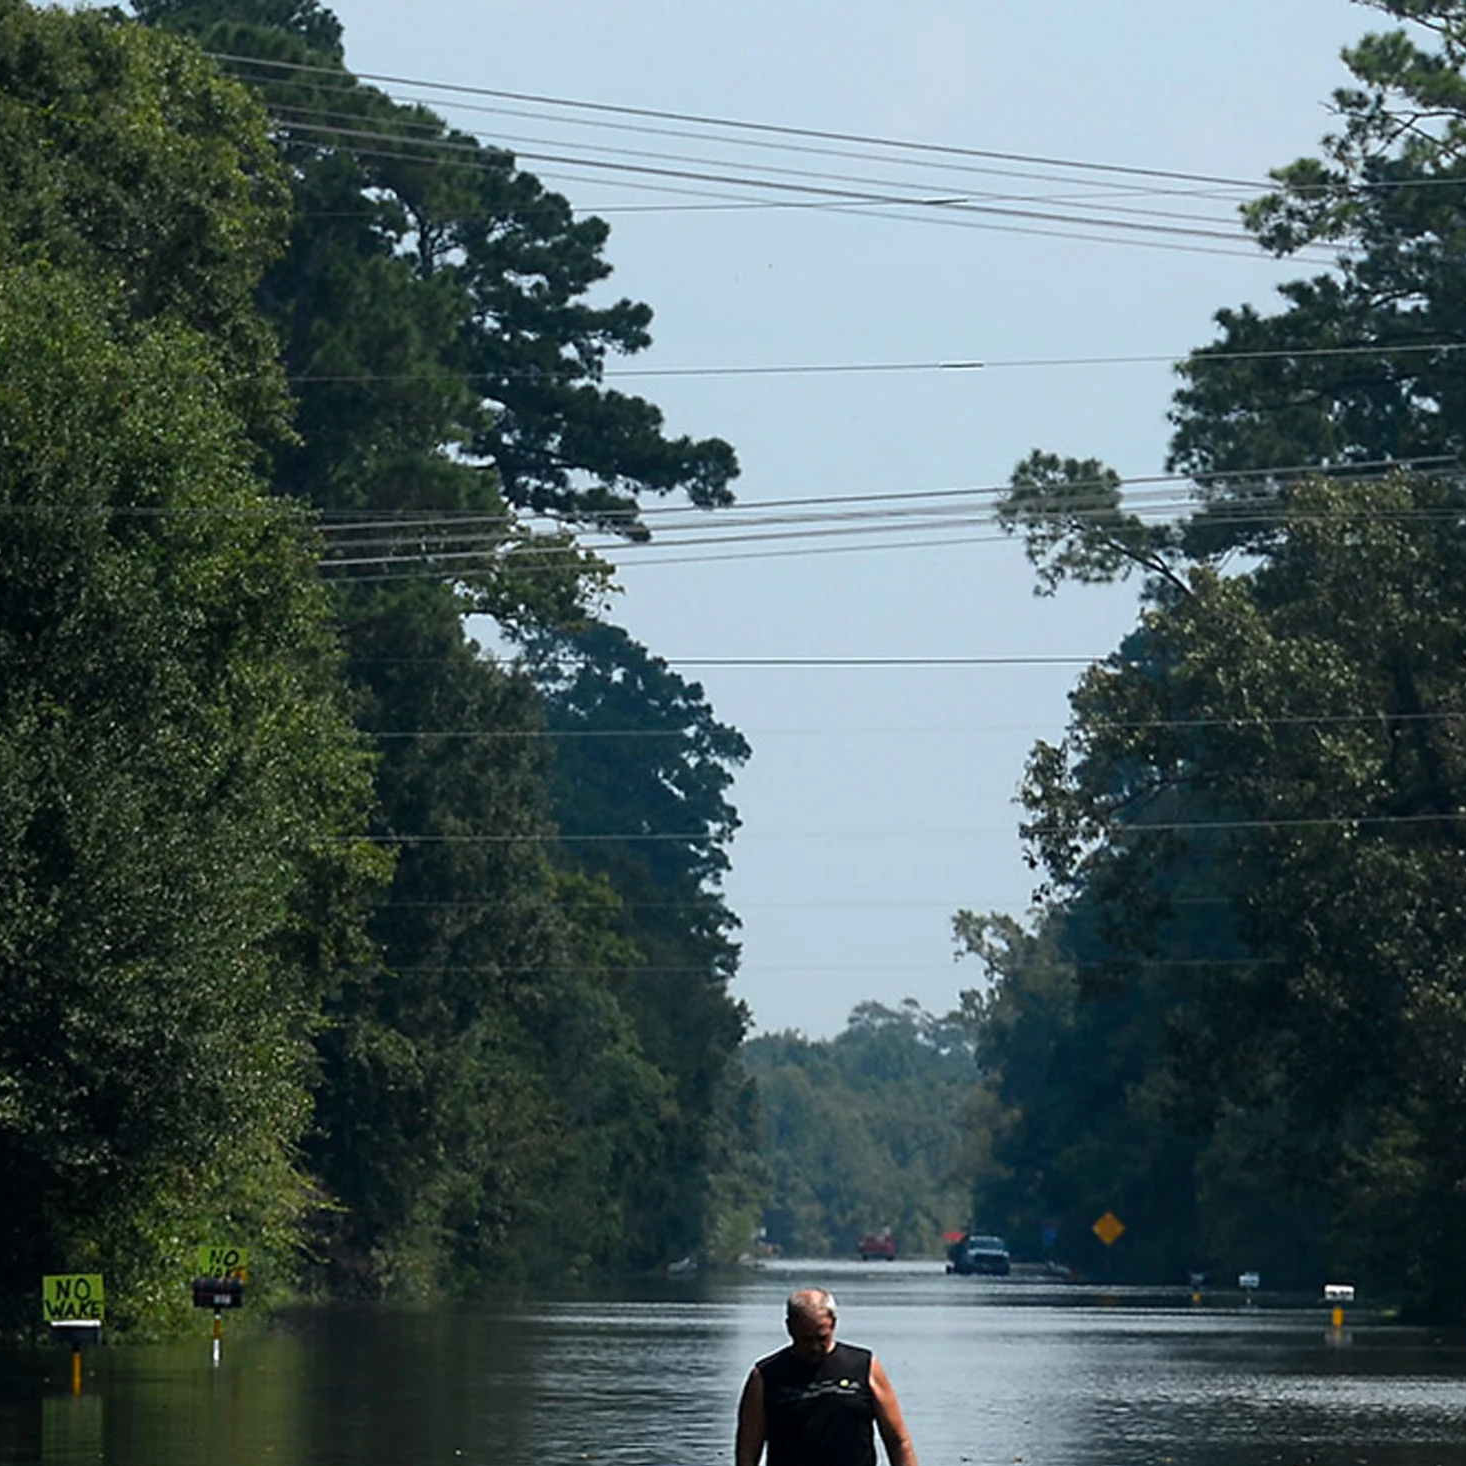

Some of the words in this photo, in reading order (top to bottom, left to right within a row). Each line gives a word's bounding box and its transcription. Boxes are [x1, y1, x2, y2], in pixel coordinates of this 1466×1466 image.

[209, 1250, 239, 1266] NO
[56, 1278, 91, 1300] NO
[45, 1299, 102, 1319] WAKE
